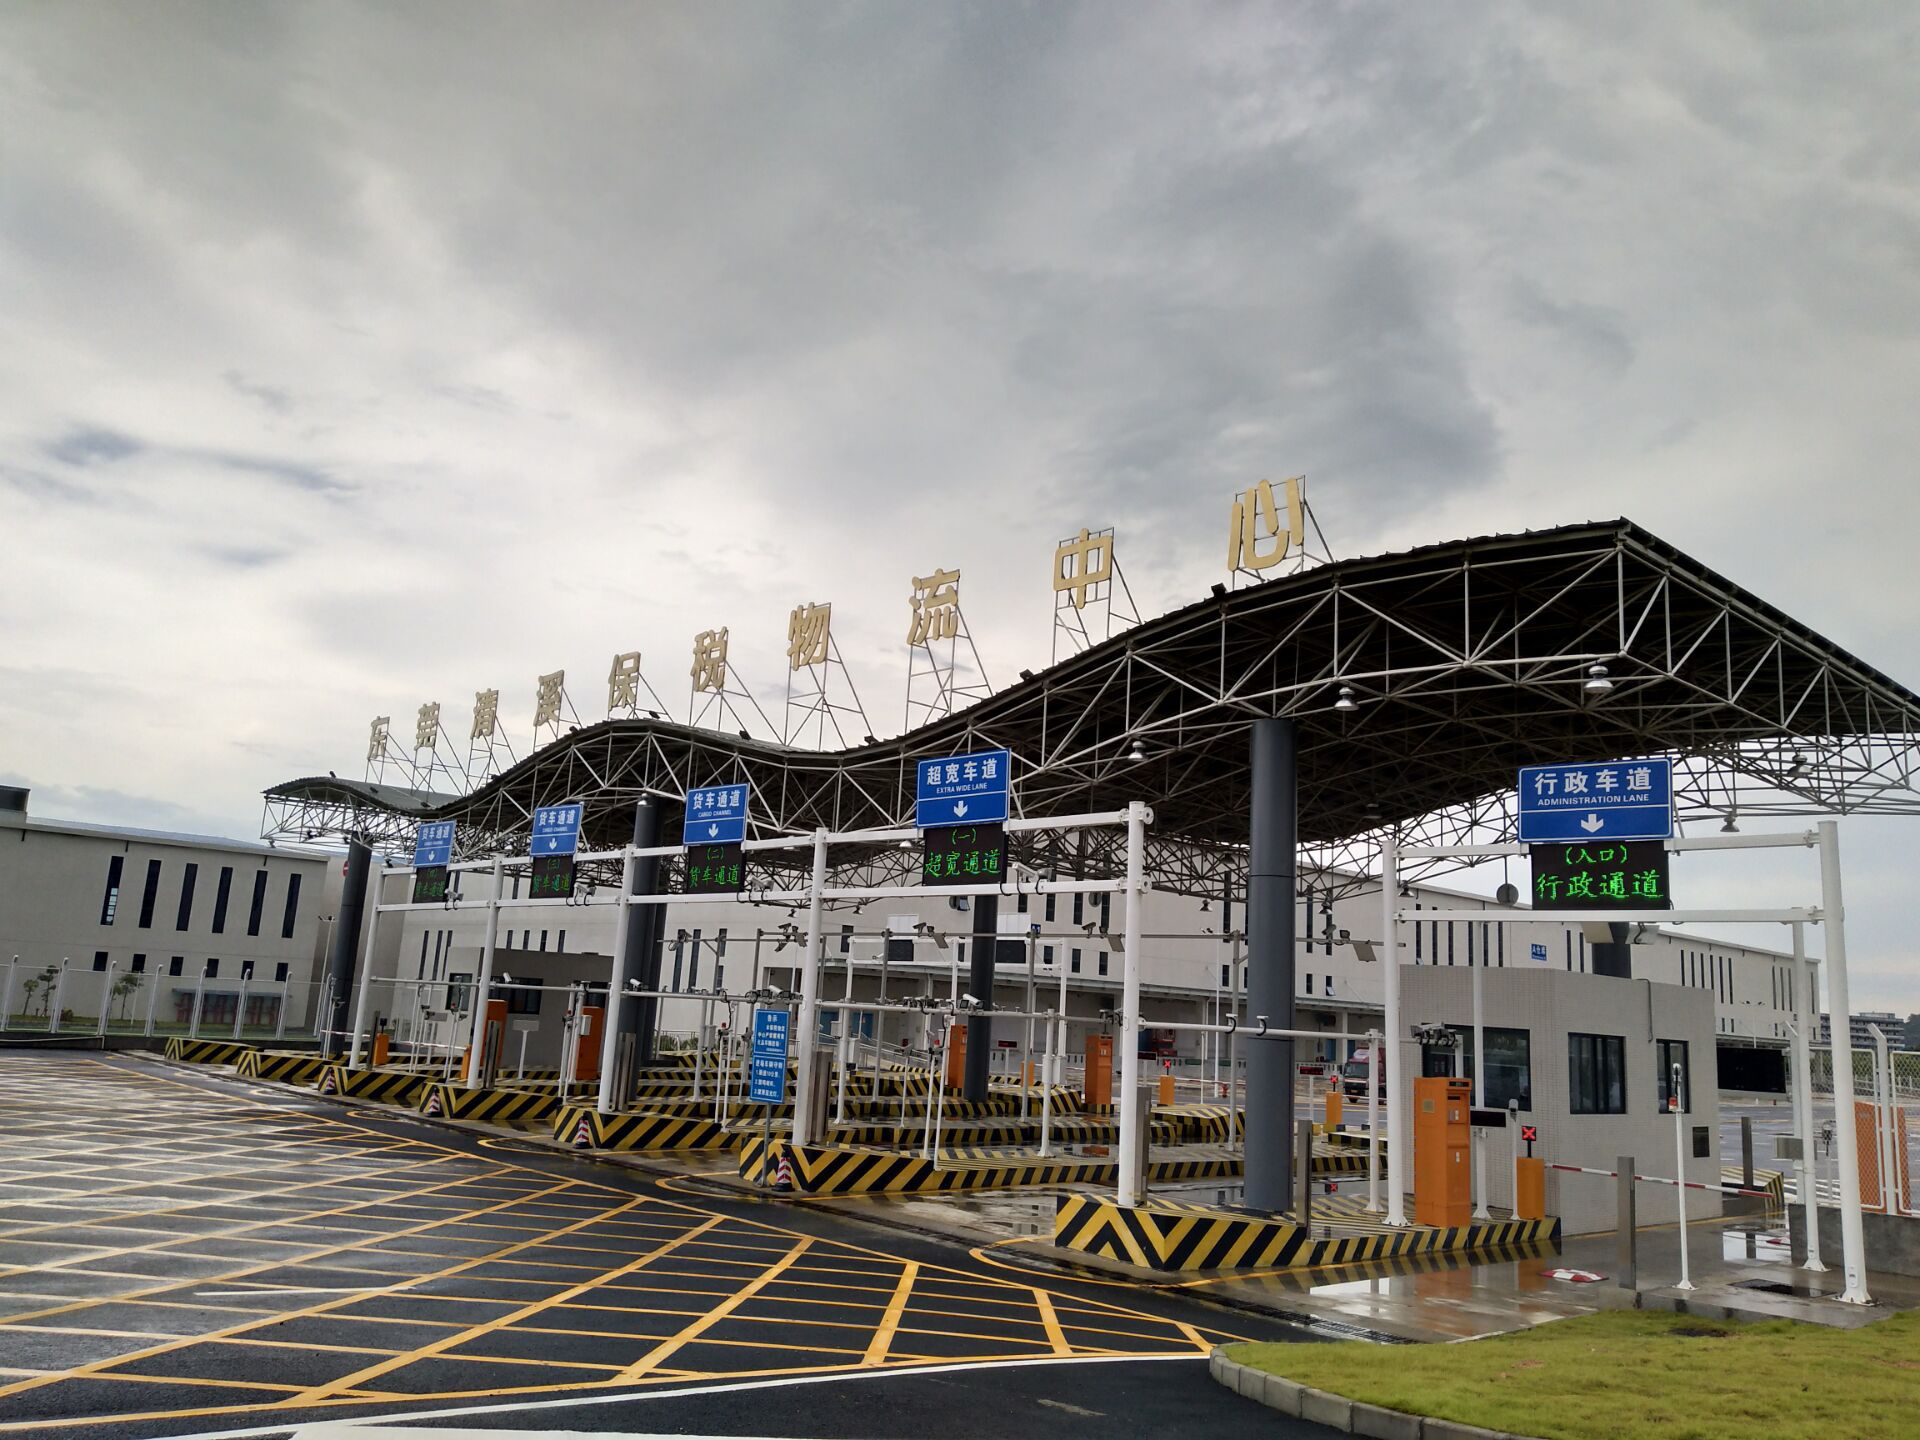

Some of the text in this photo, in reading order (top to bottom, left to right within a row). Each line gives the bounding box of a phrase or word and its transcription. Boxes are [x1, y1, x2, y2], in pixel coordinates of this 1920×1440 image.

[926, 757, 998, 786] 超宽车道
[1534, 766, 1653, 796] 行政车道
[692, 789, 741, 810] 货车通道
[936, 782, 988, 794] EXTRA WIDE LANE
[1537, 793, 1650, 807] ADMINISTRATION LANE
[924, 848, 1001, 878] 超宽通道
[1565, 844, 1628, 865] (入口)
[689, 863, 740, 889] 货车通道
[1536, 869, 1664, 901] 行政通道
